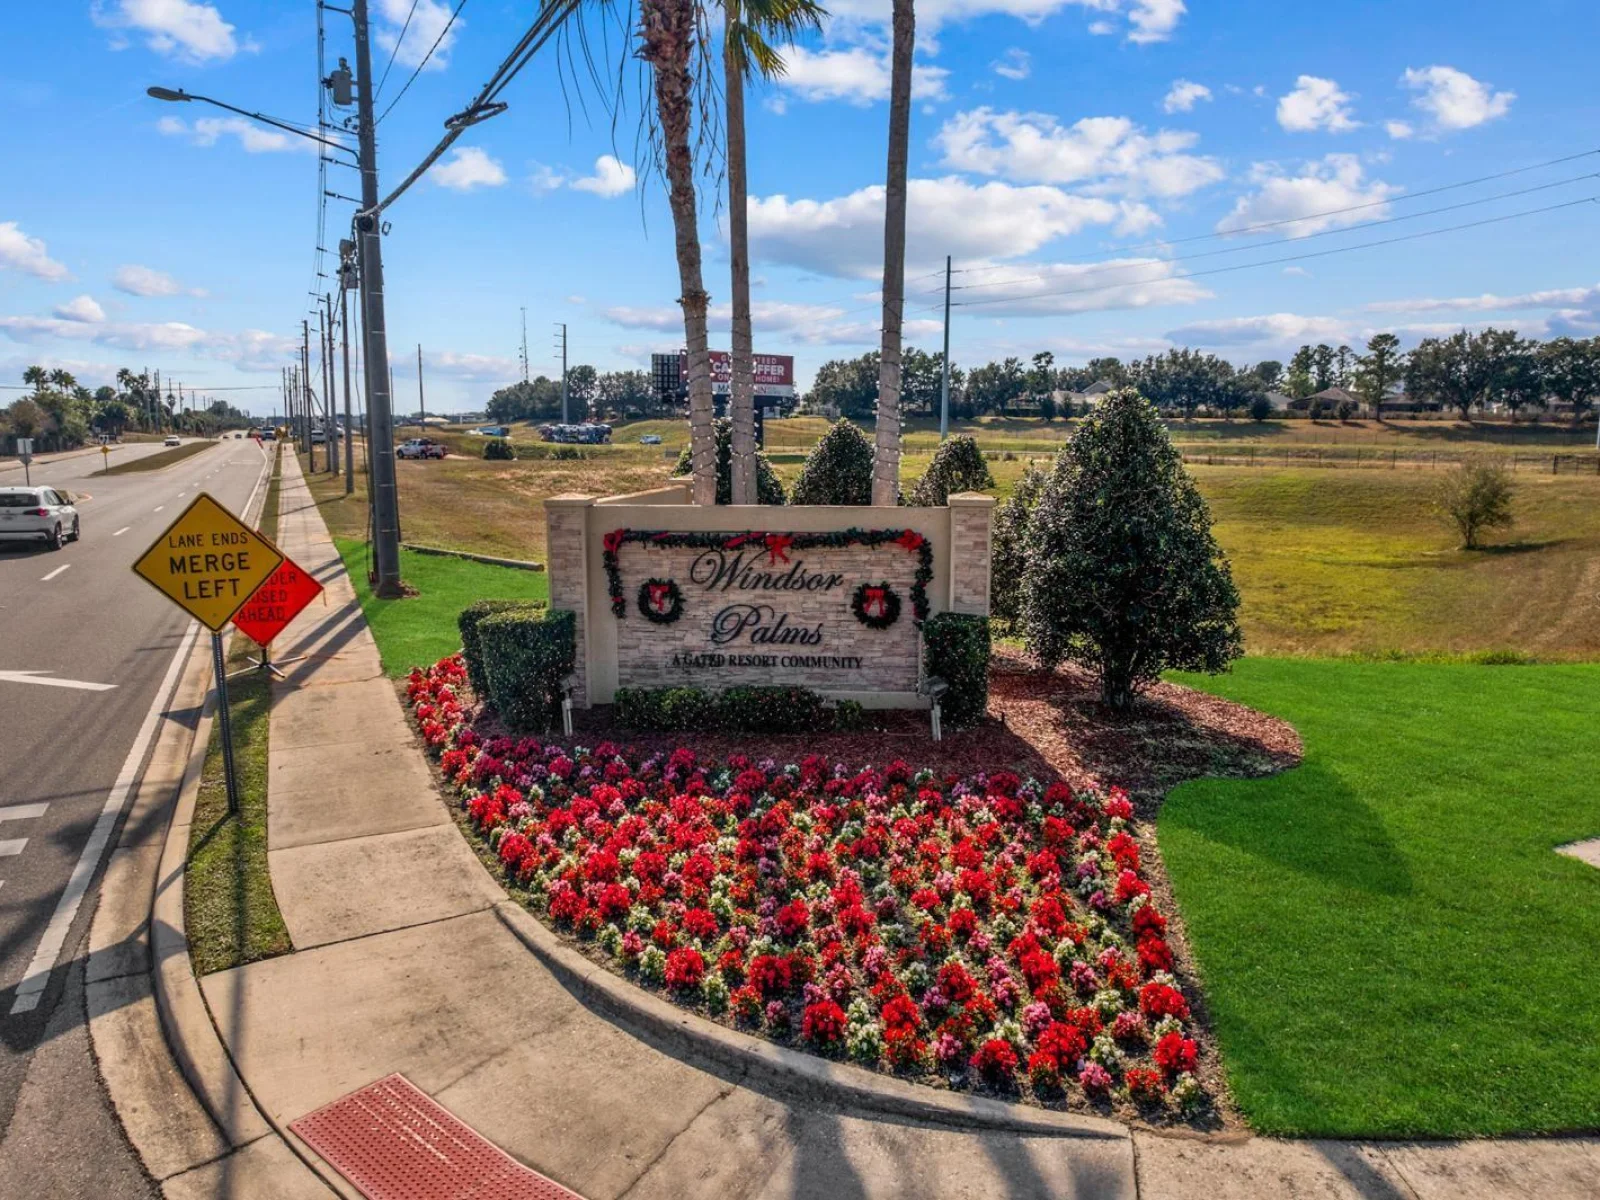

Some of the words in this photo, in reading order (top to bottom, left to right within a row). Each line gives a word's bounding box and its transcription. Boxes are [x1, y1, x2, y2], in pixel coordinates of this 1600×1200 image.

[755, 365, 784, 376] FFER
[169, 533, 204, 548] LANE
[212, 532, 248, 546] ENDS
[169, 552, 251, 575] MERGE
[690, 547, 844, 592] Windsor
[183, 578, 240, 600] LEFT
[238, 606, 286, 622] AHEAD
[711, 604, 824, 645] Palms
[672, 653, 680, 667] A
[683, 653, 724, 667] GATED
[729, 653, 777, 667] RESORT
[781, 655, 864, 669] COMMUNITY
